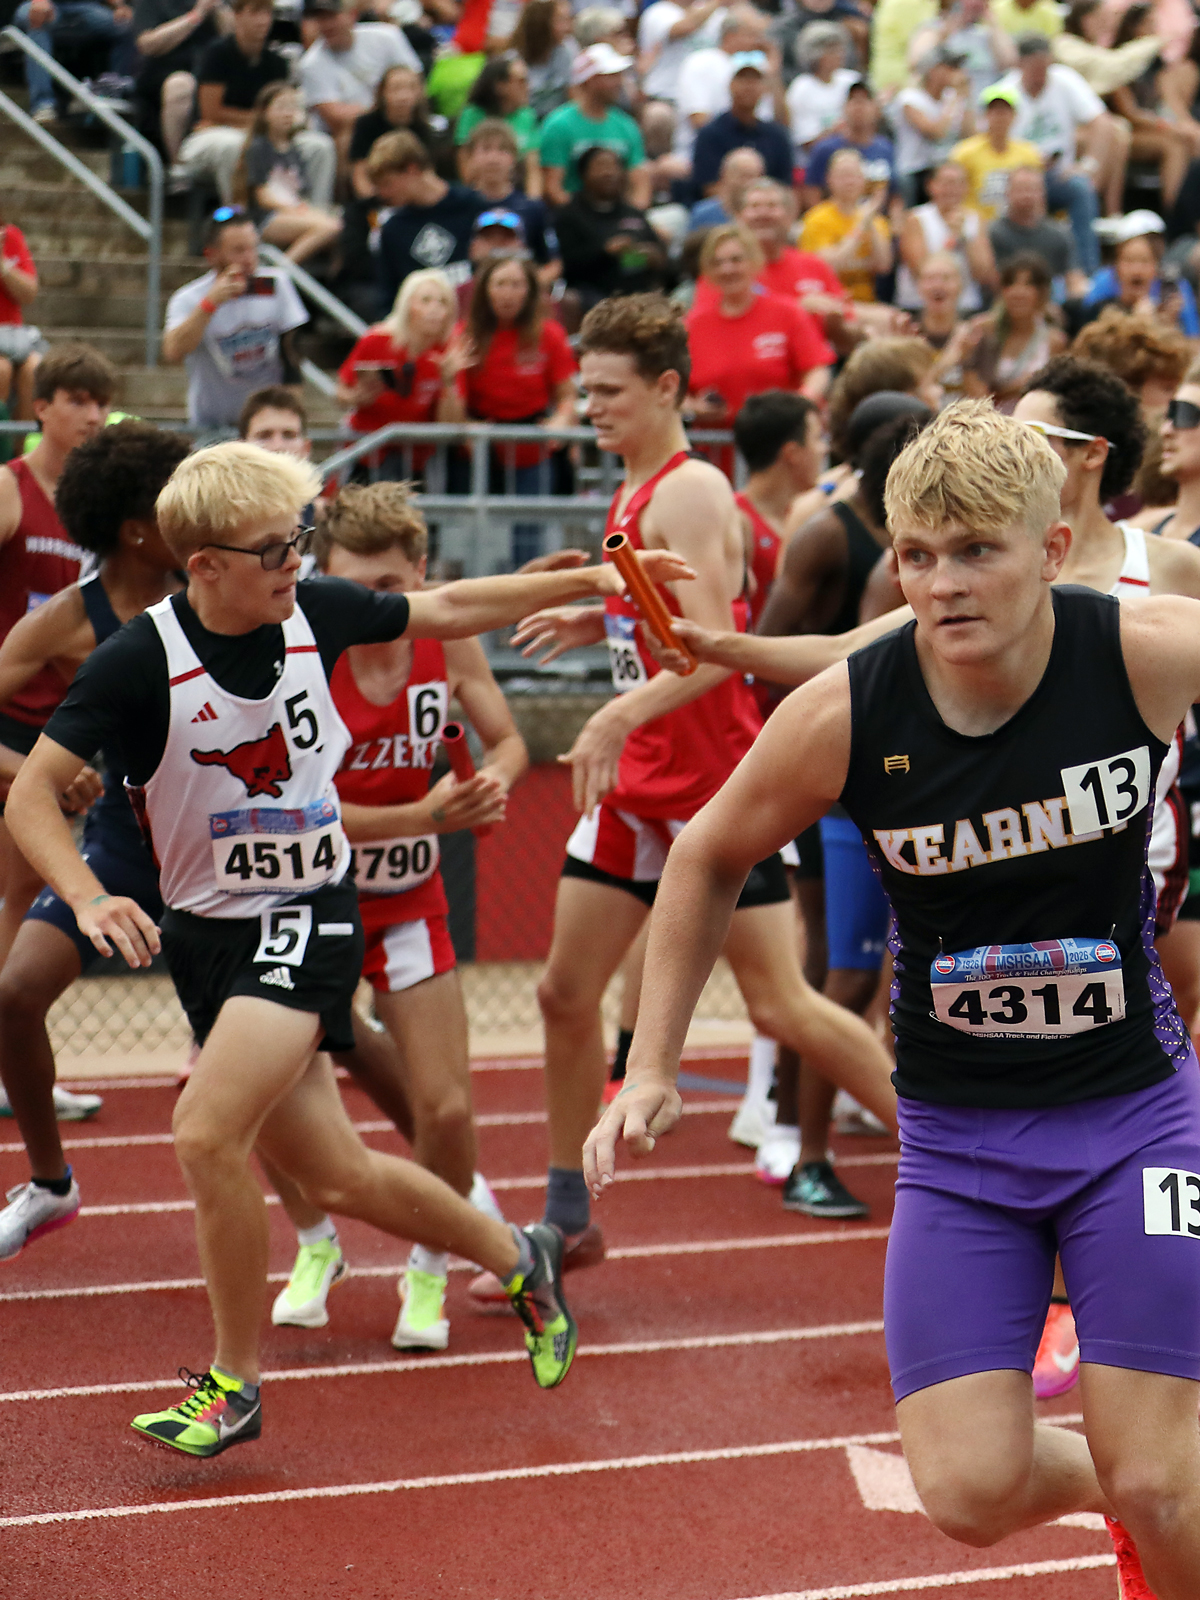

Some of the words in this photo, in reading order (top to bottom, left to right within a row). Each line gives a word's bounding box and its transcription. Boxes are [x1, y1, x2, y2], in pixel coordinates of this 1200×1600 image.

[284, 690, 319, 749] 5
[415, 688, 440, 738] 6
[1079, 757, 1139, 821] 13
[224, 834, 336, 880] 4514
[872, 796, 1128, 876] KEARN
[264, 911, 300, 957] 5
[962, 957, 980, 970] 1926
[995, 954, 1050, 971] MSHSAA
[1040, 967, 1087, 978] Championships
[1069, 952, 1089, 963] 2026
[948, 982, 1113, 1026] 4314
